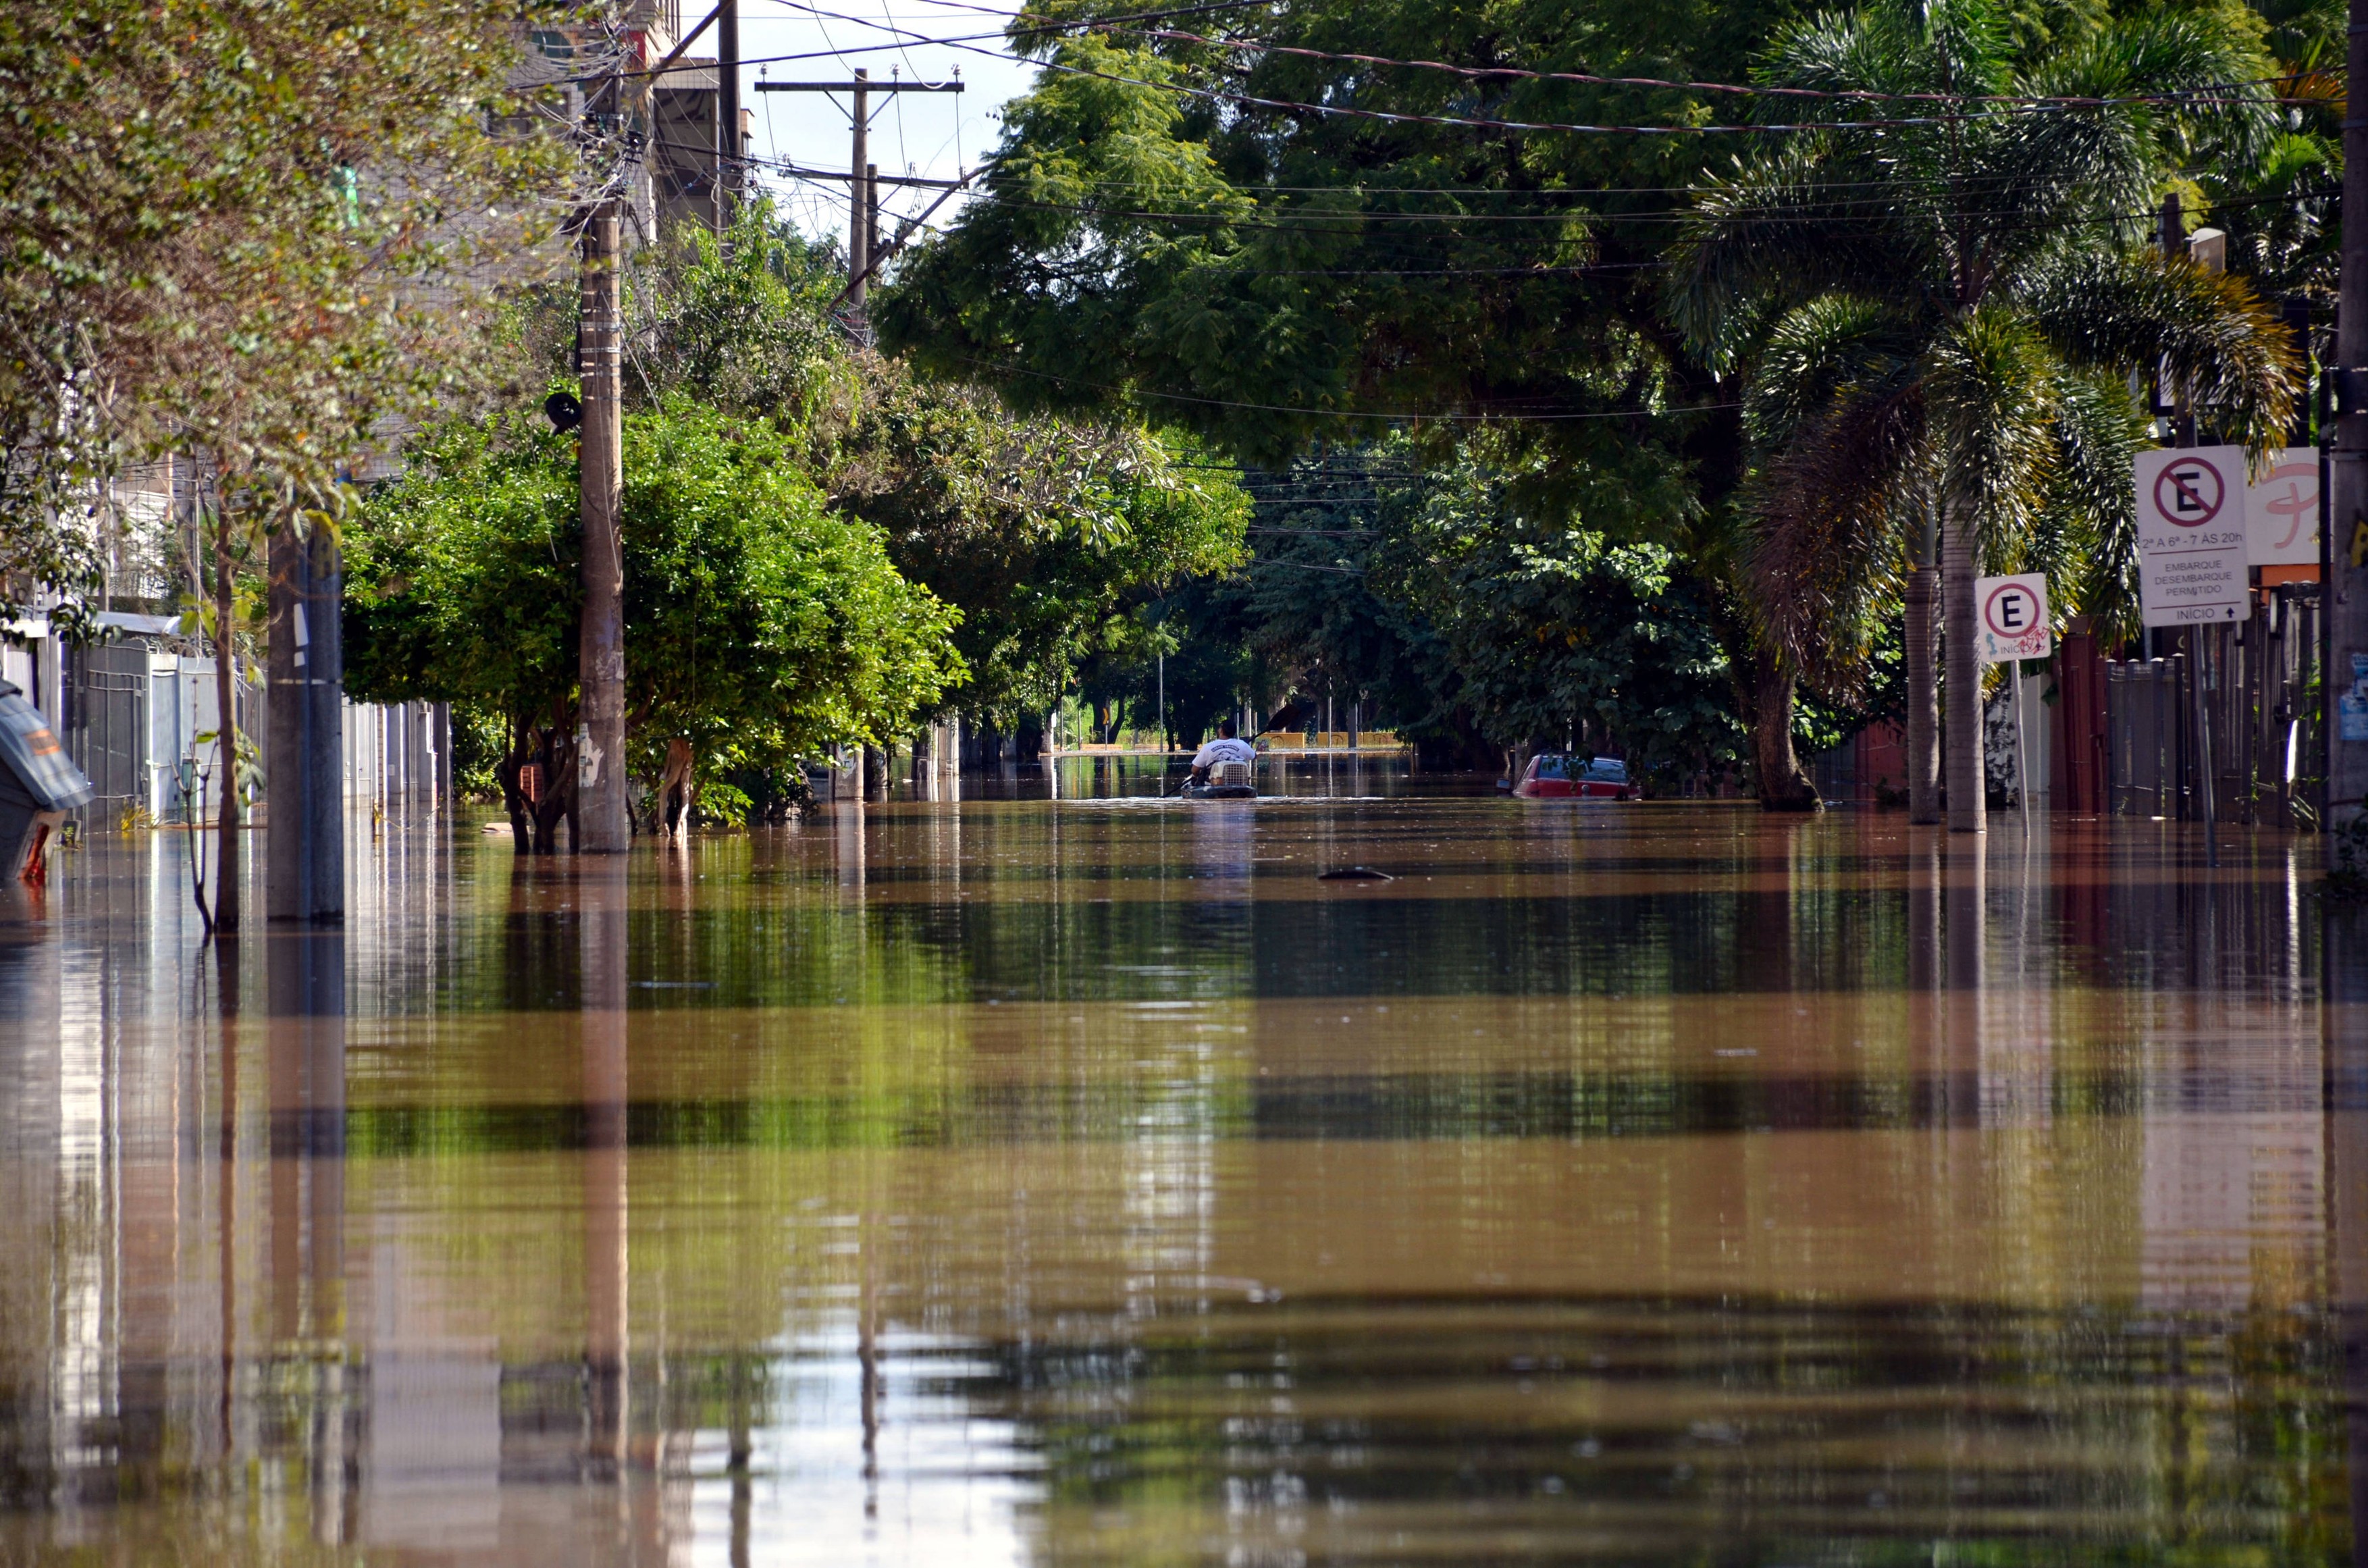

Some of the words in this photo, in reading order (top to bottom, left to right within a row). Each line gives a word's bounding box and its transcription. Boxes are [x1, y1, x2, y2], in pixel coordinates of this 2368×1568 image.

[2176, 472, 2201, 512] E
[2157, 538, 2165, 548] A
[2190, 534, 2197, 544] 7
[2221, 532, 2242, 543] 20h
[2165, 560, 2222, 572] EMBARQUE
[2155, 572, 2232, 585] DESEMBARQUE
[2165, 584, 2221, 596] PERMITIDO
[2001, 595, 2023, 627] E
[2177, 607, 2215, 620] INÍCIO
